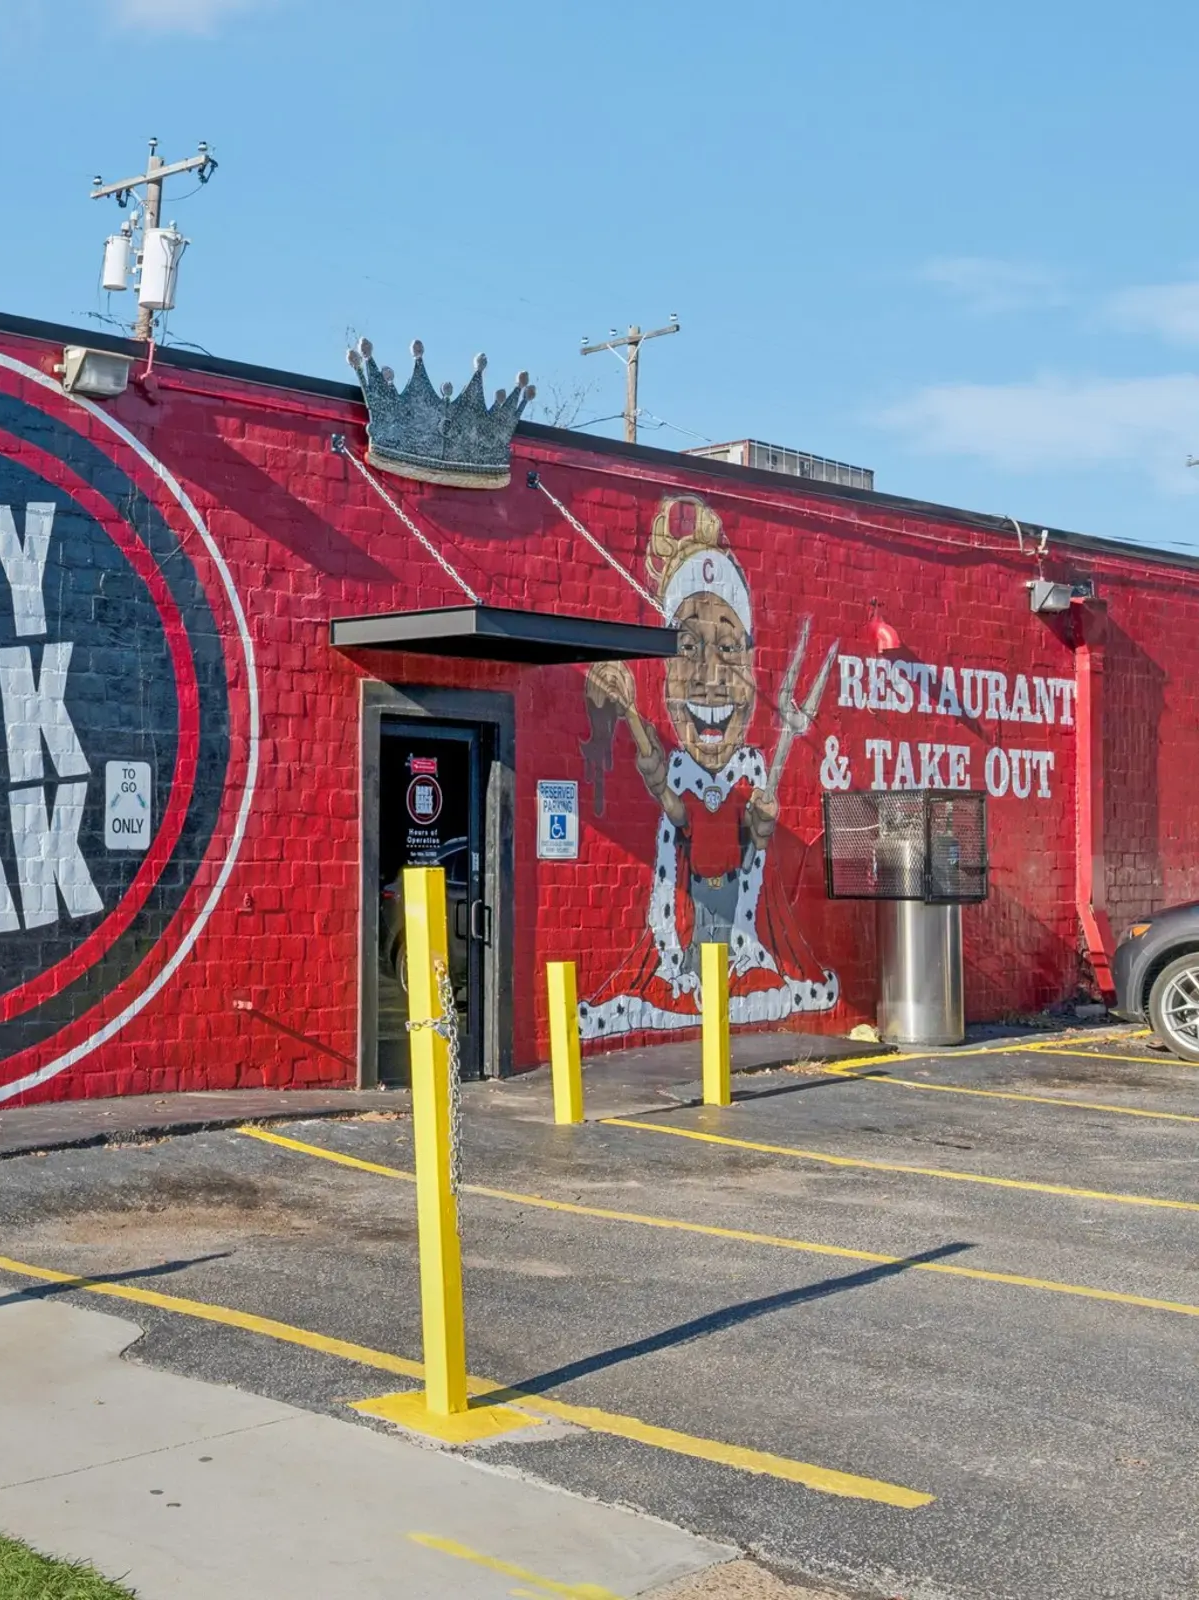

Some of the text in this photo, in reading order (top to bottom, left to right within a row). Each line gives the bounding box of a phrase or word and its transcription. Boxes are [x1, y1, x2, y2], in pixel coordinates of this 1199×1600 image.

[703, 558, 714, 584] C
[837, 654, 1076, 726] RESTAURANT
[122, 768, 136, 779] TO
[820, 735, 1055, 799] & TAKE OUT
[121, 782, 137, 793] GO
[540, 786, 575, 799] RESERVED
[543, 800, 573, 813] PARKING
[112, 818, 144, 834] ONLY
